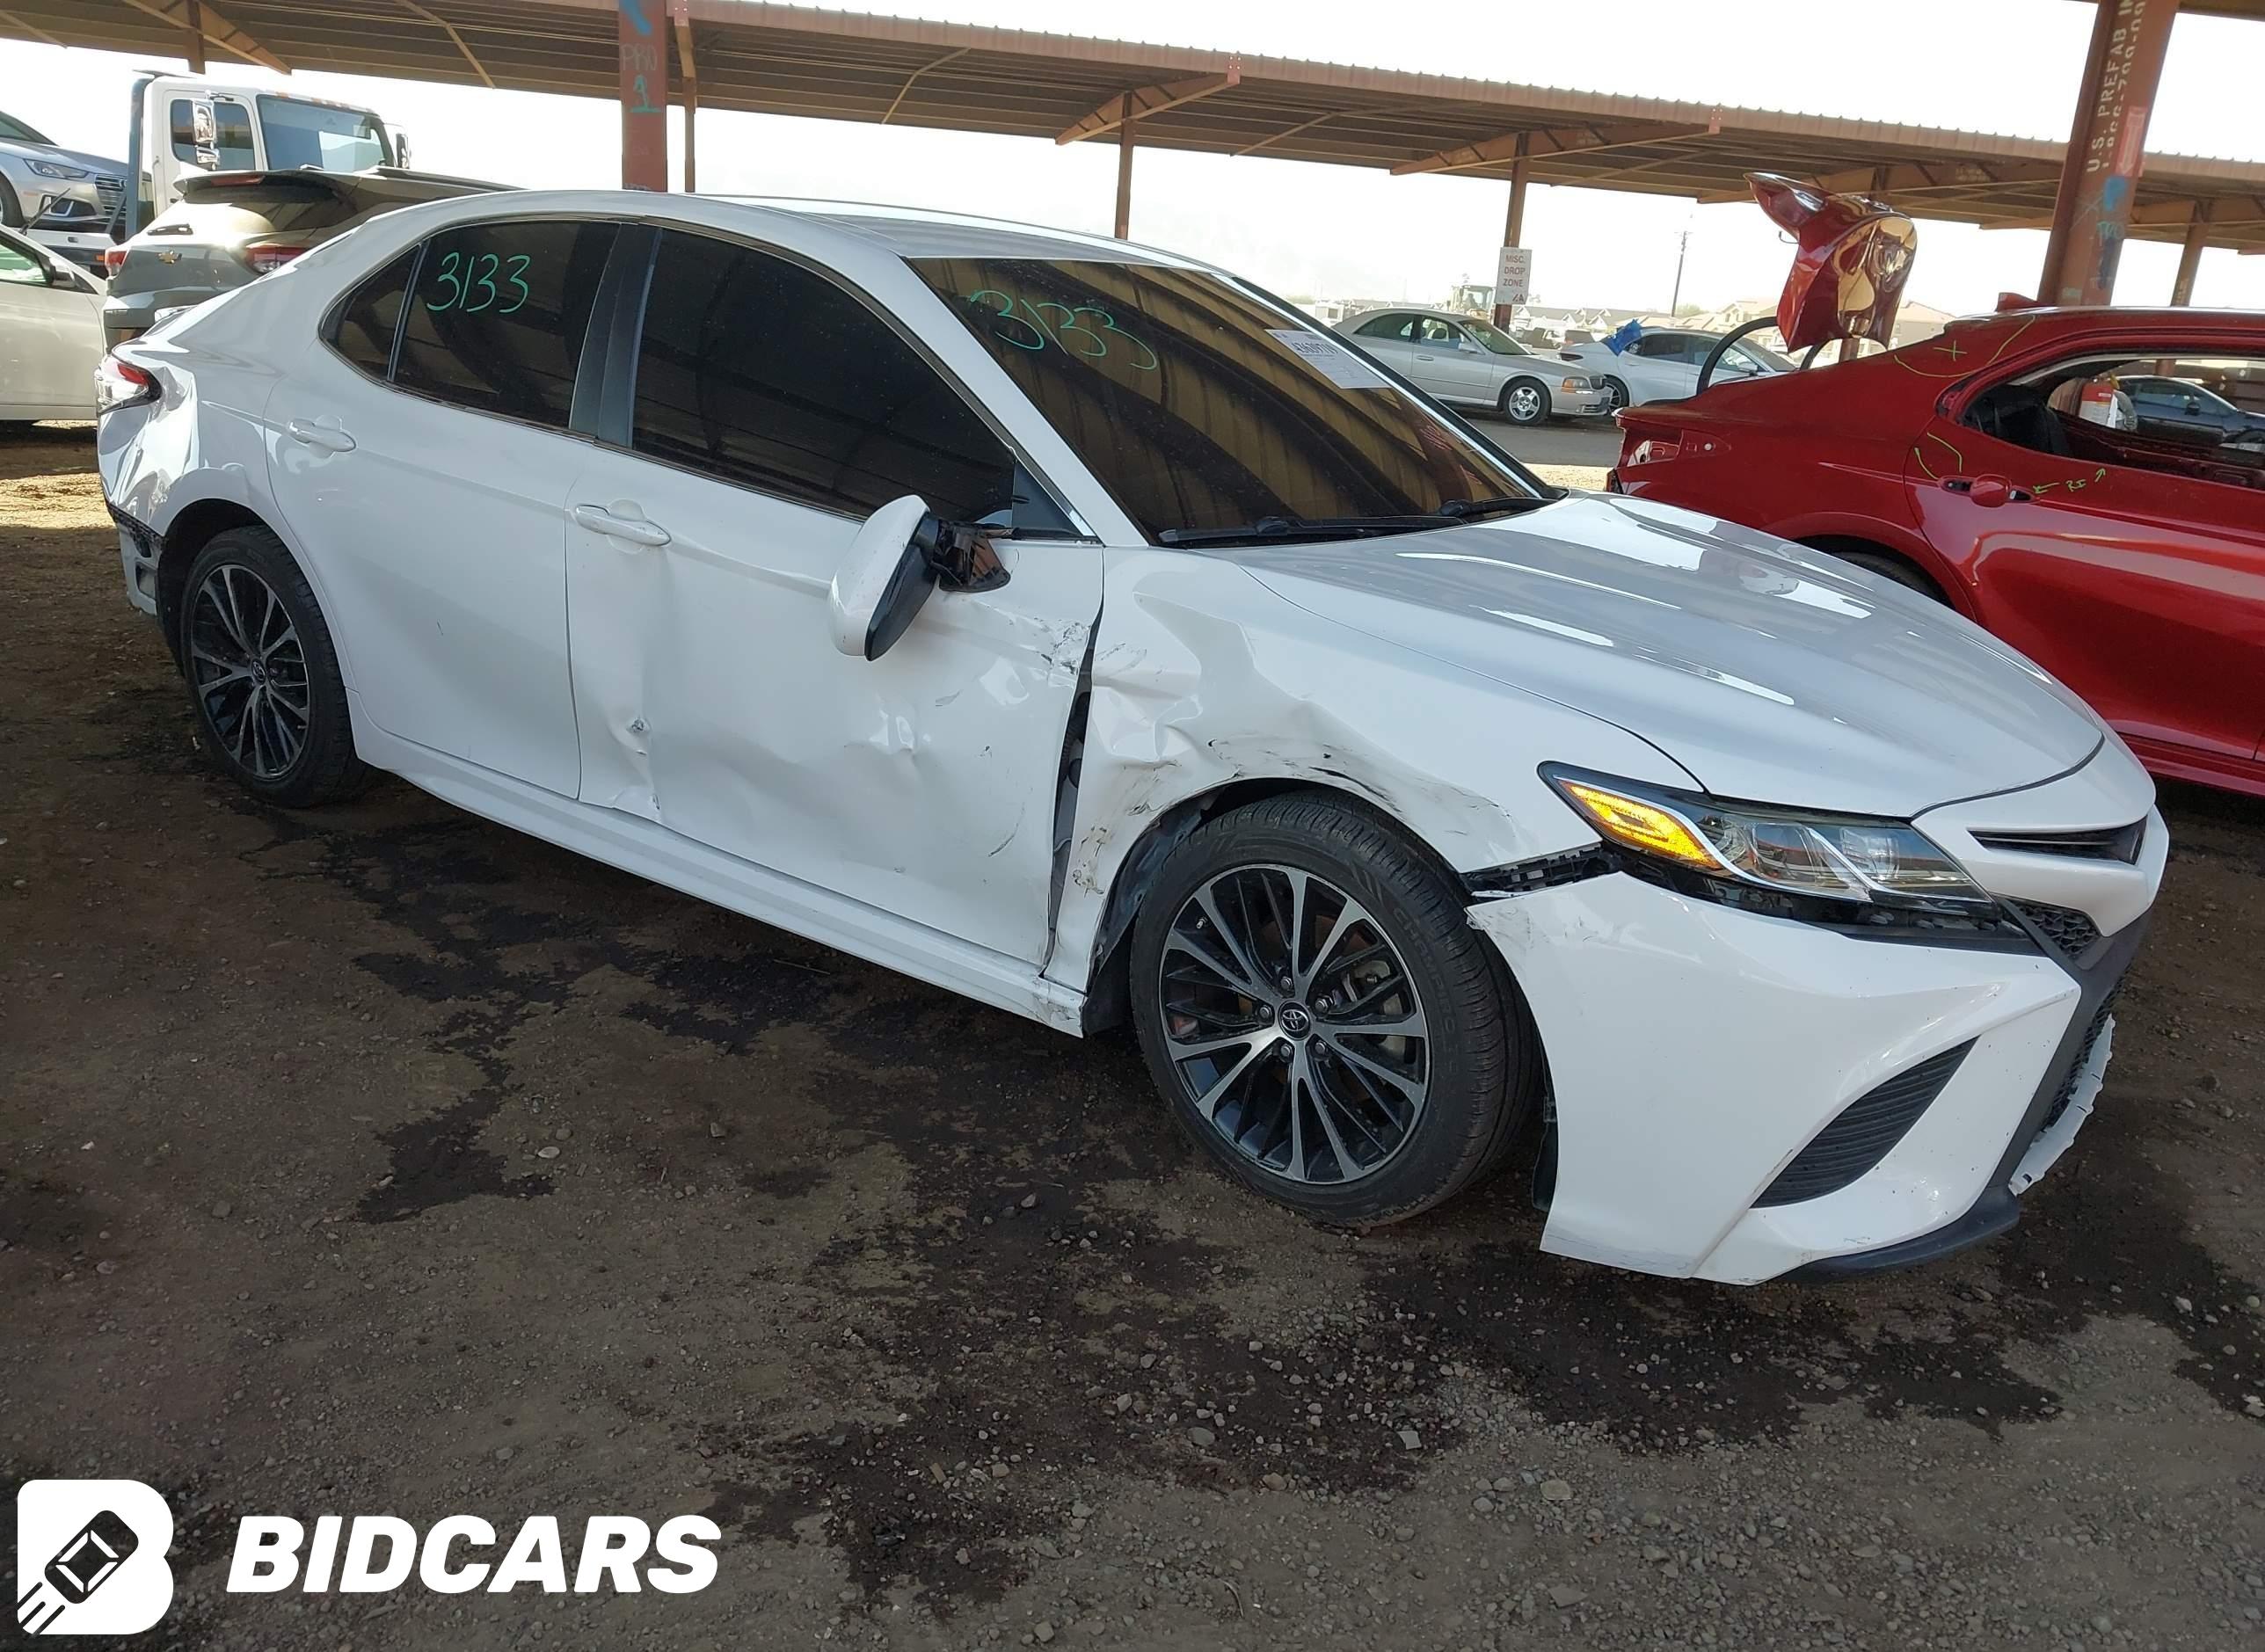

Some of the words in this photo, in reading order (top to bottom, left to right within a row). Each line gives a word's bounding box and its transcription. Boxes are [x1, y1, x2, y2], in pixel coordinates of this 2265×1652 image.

[2087, 129, 2107, 172] U.S.
[2098, 27, 2128, 117] PREFAB
[426, 251, 531, 313] 3133
[1503, 279, 1524, 287] ZONE
[1504, 266, 1526, 275] DROP
[970, 289, 1158, 370] 3133
